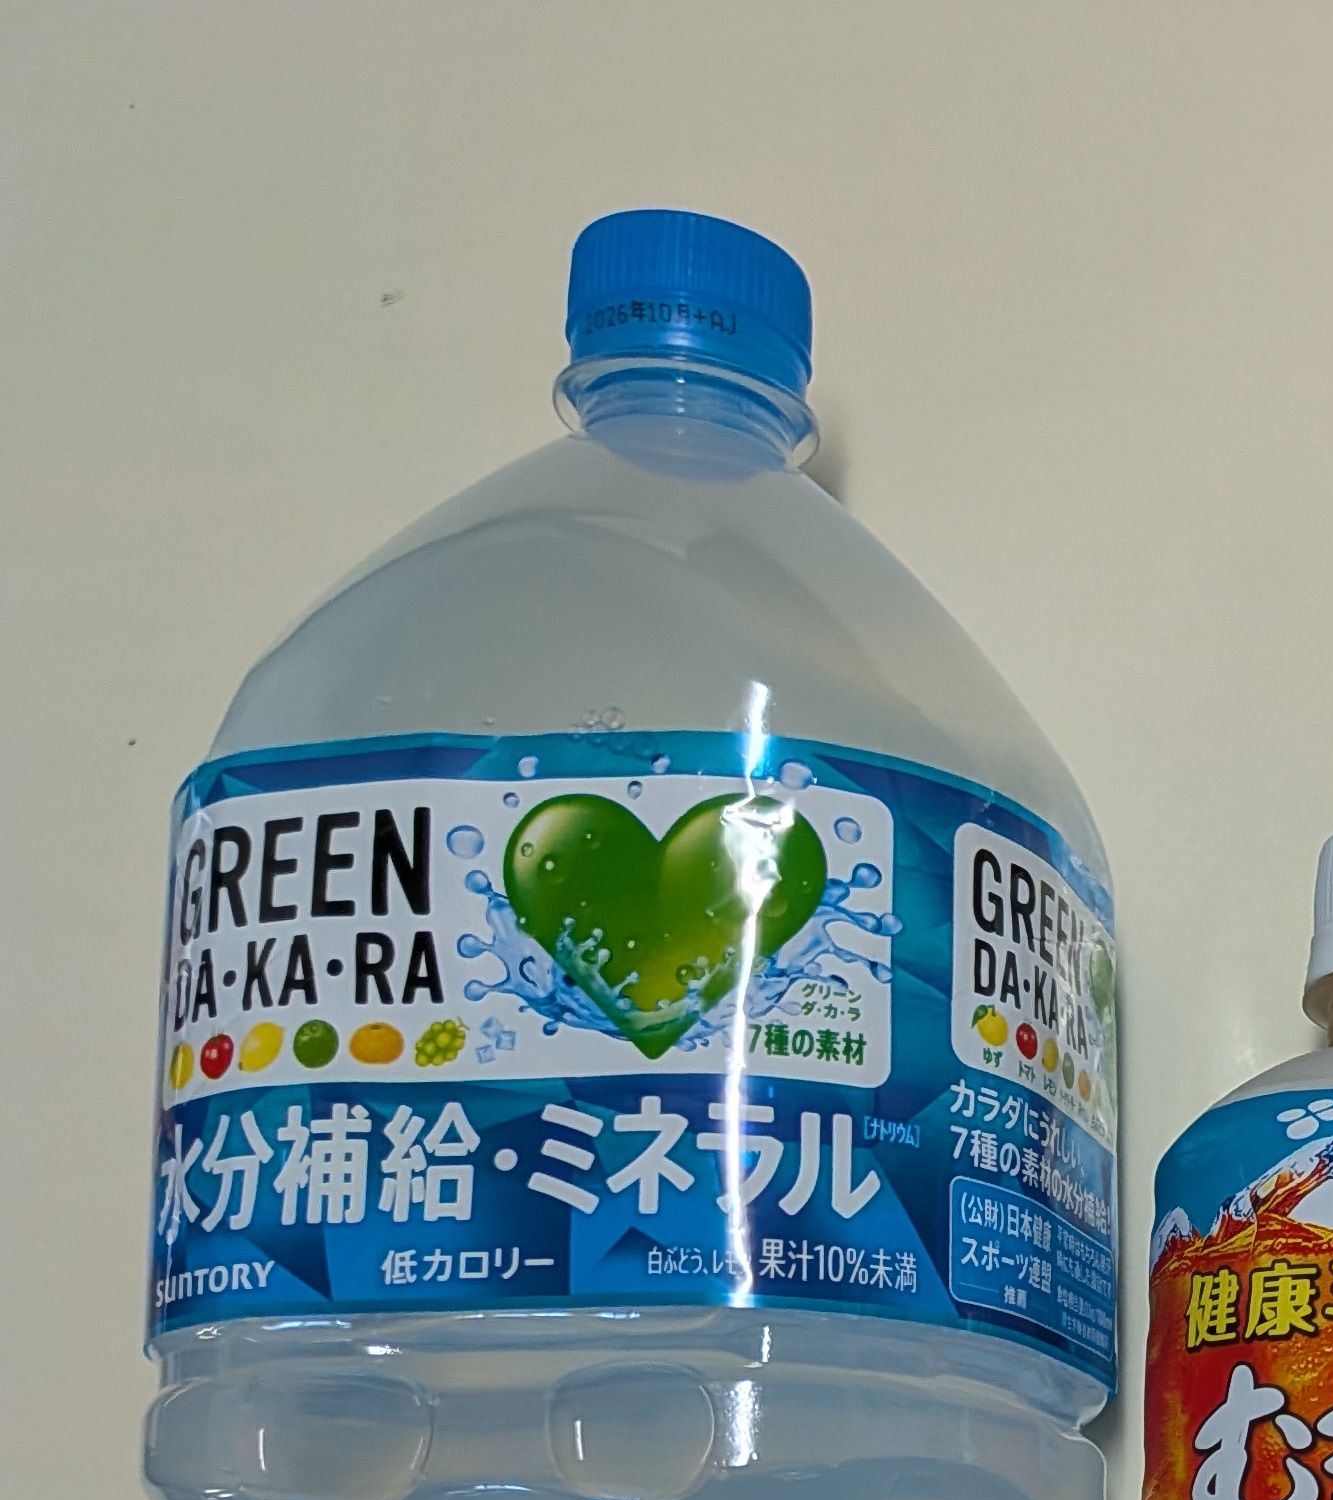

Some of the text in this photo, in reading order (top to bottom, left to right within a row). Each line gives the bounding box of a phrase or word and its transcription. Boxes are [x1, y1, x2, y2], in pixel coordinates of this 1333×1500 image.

[179, 806, 432, 947] GREEN
[972, 847, 1085, 995] GREEN
[746, 1024, 868, 1067] 7種の素材
[154, 1259, 277, 1308] SUNTORY
[381, 1246, 555, 1286] 低カロリー
